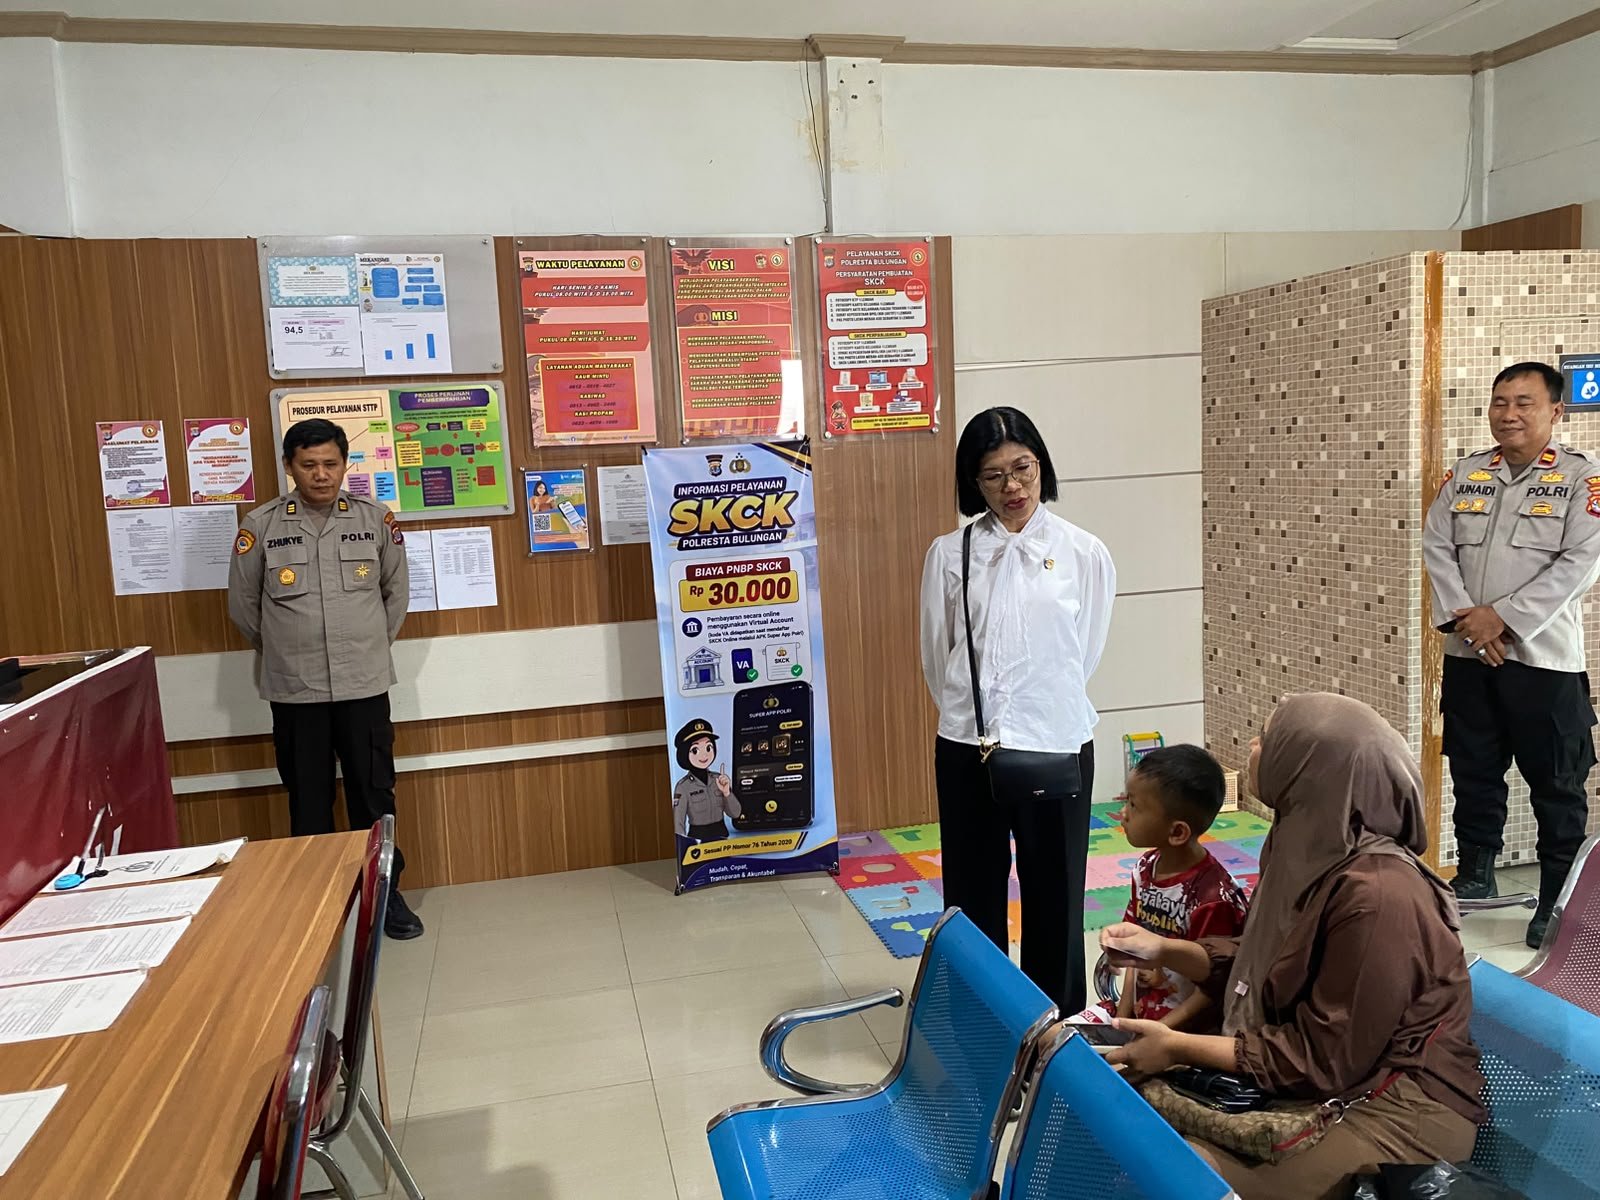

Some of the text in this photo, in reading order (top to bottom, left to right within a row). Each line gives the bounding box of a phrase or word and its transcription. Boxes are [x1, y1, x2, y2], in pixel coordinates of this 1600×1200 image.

[536, 259, 625, 269] WAKTU PELAYANAN
[708, 260, 734, 270] VISI
[712, 312, 738, 320] MISI
[292, 404, 378, 415] PROSEDUR PELAYANAN STTP
[678, 480, 783, 496] INFORMASI PELAYANAN
[1456, 484, 1496, 496] JUNAIDI
[1526, 486, 1568, 498] POLRI
[669, 492, 797, 534] SKCK
[267, 536, 303, 548] ZHUKYE
[341, 533, 375, 542] POLRI
[682, 532, 782, 548] POLRESTA BULUNGAN
[695, 561, 782, 577] BIAYA PNBP SKCK
[690, 577, 791, 606] Rp 30.000
[707, 615, 742, 623] Pembayaran
[736, 661, 750, 669] VA
[709, 864, 748, 874] Mudah, Cepat,
[710, 872, 740, 883] Transparan
[747, 869, 776, 877] Akuntabel
